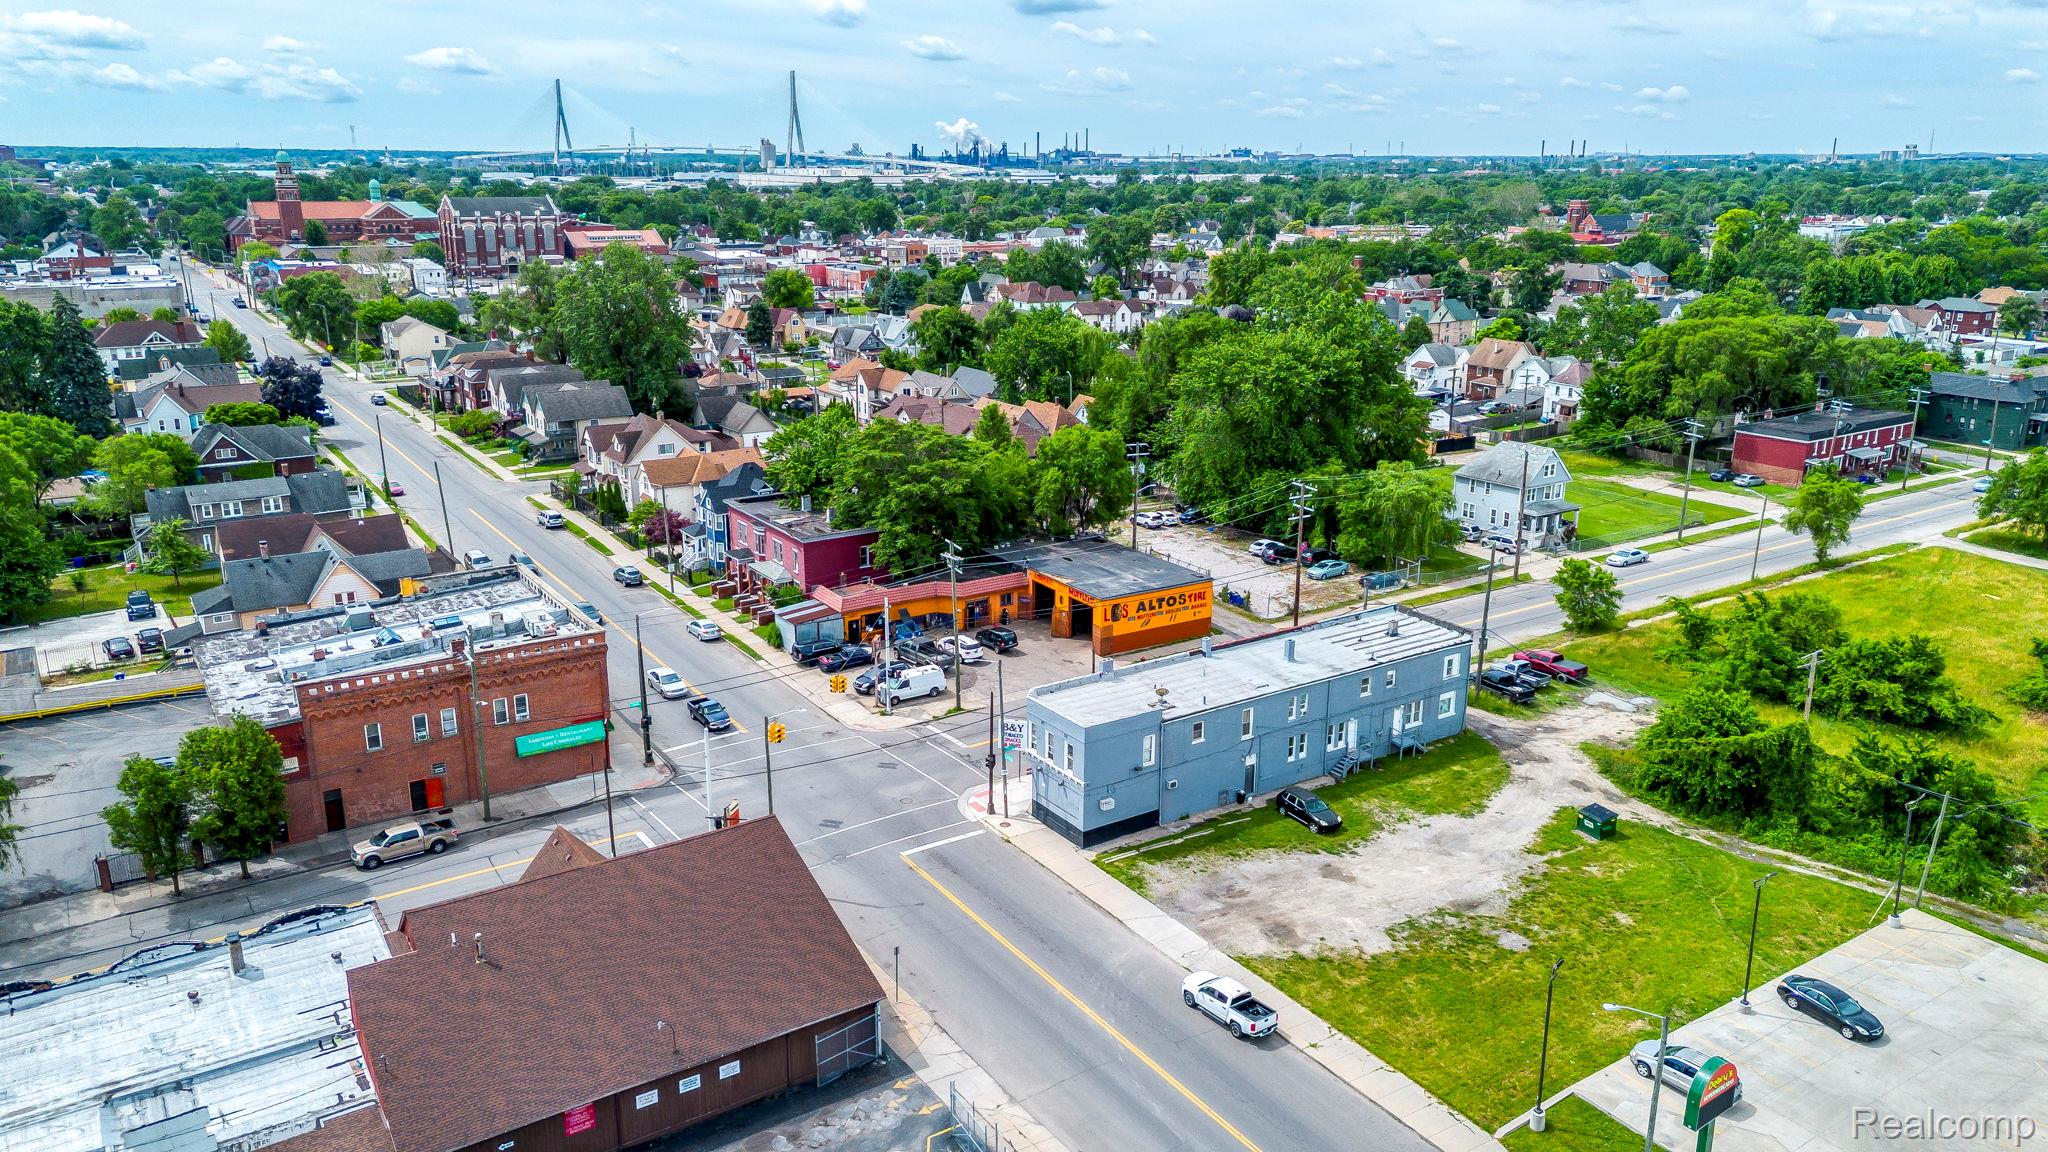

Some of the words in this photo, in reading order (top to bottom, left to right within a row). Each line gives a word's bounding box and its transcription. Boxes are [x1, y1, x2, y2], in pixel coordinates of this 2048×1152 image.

[1103, 603, 1129, 623] LOS
[1136, 593, 1187, 613] ALTOS
[1187, 591, 1207, 603] TIRE
[1003, 722, 1024, 732] B&Y
